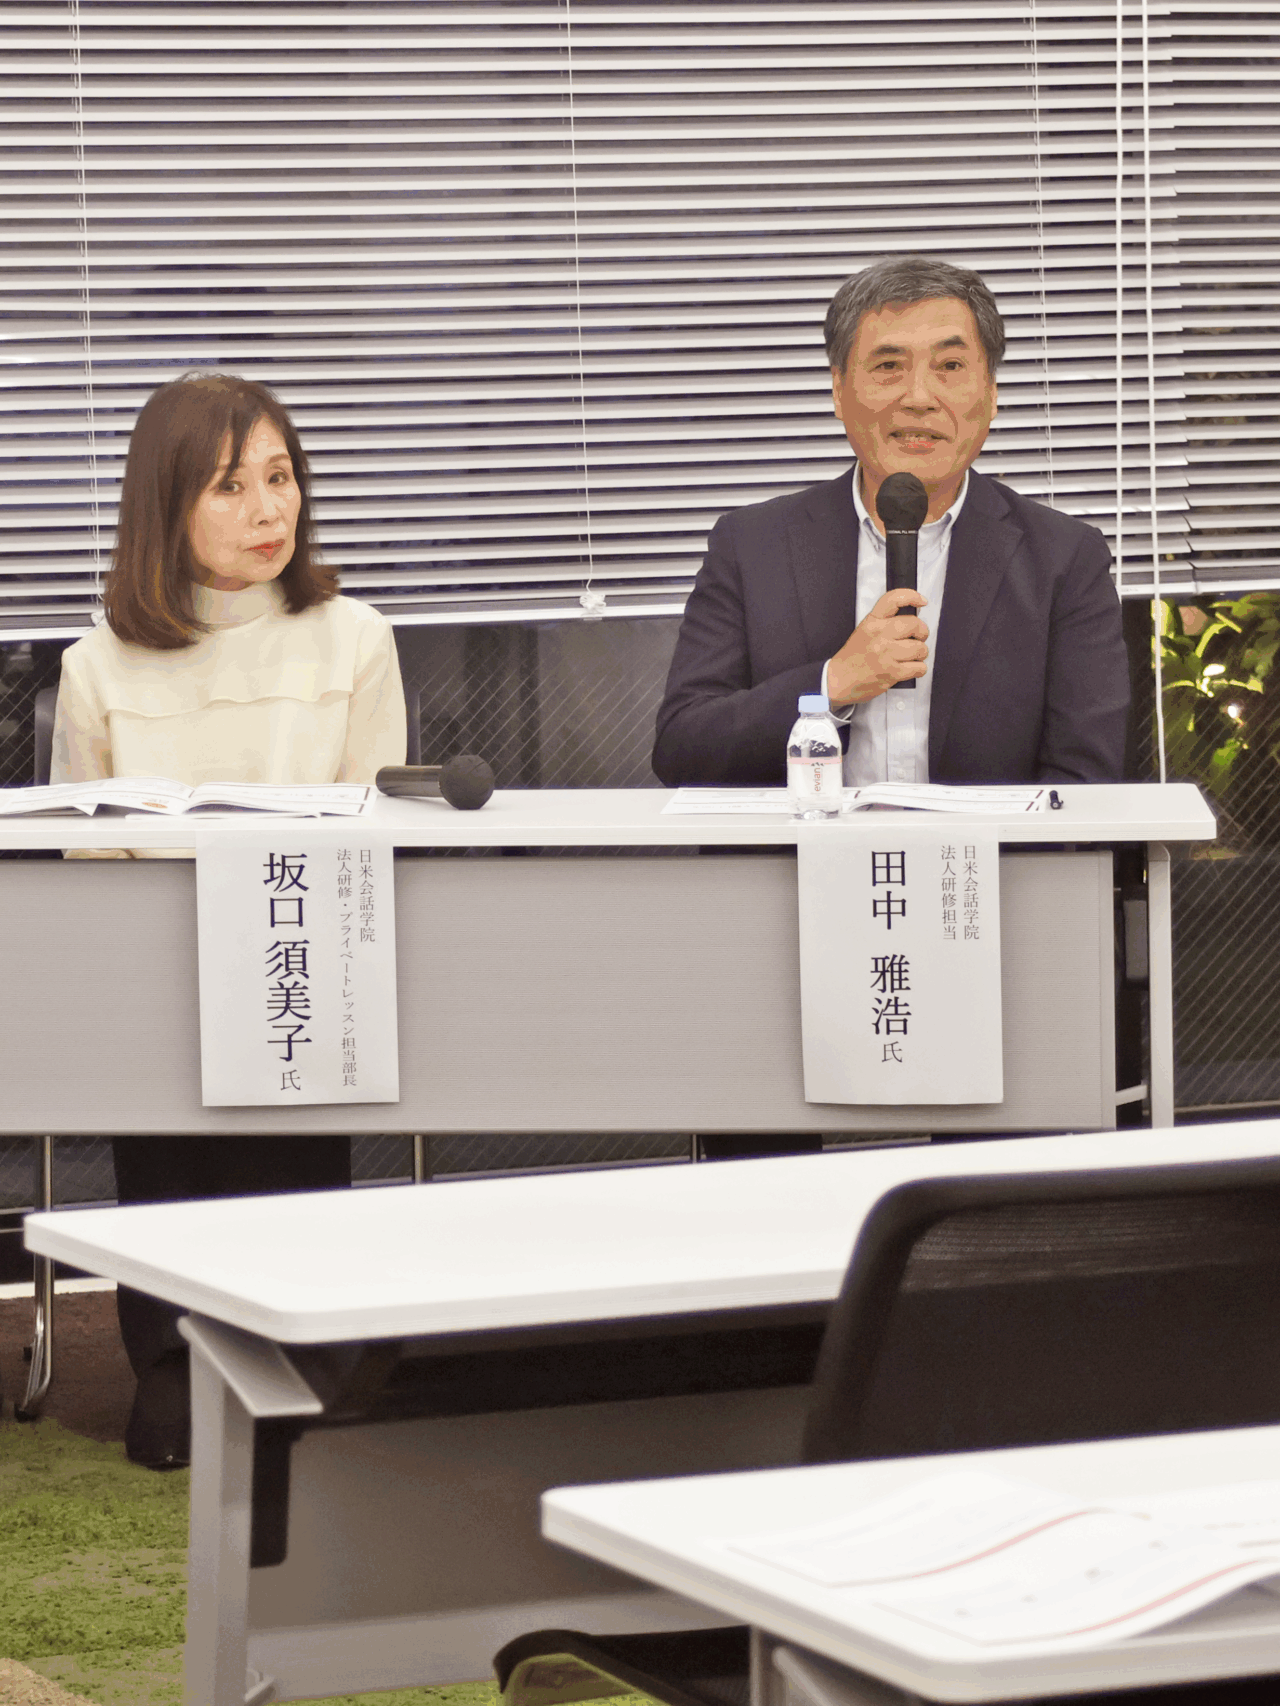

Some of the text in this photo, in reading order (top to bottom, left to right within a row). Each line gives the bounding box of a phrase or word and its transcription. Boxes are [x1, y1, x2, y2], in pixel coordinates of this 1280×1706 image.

[813, 767, 822, 792] evian
[358, 848, 376, 943] 日米会話学院
[940, 844, 957, 941] 法人研修担当
[962, 845, 980, 941] 日米会話学院
